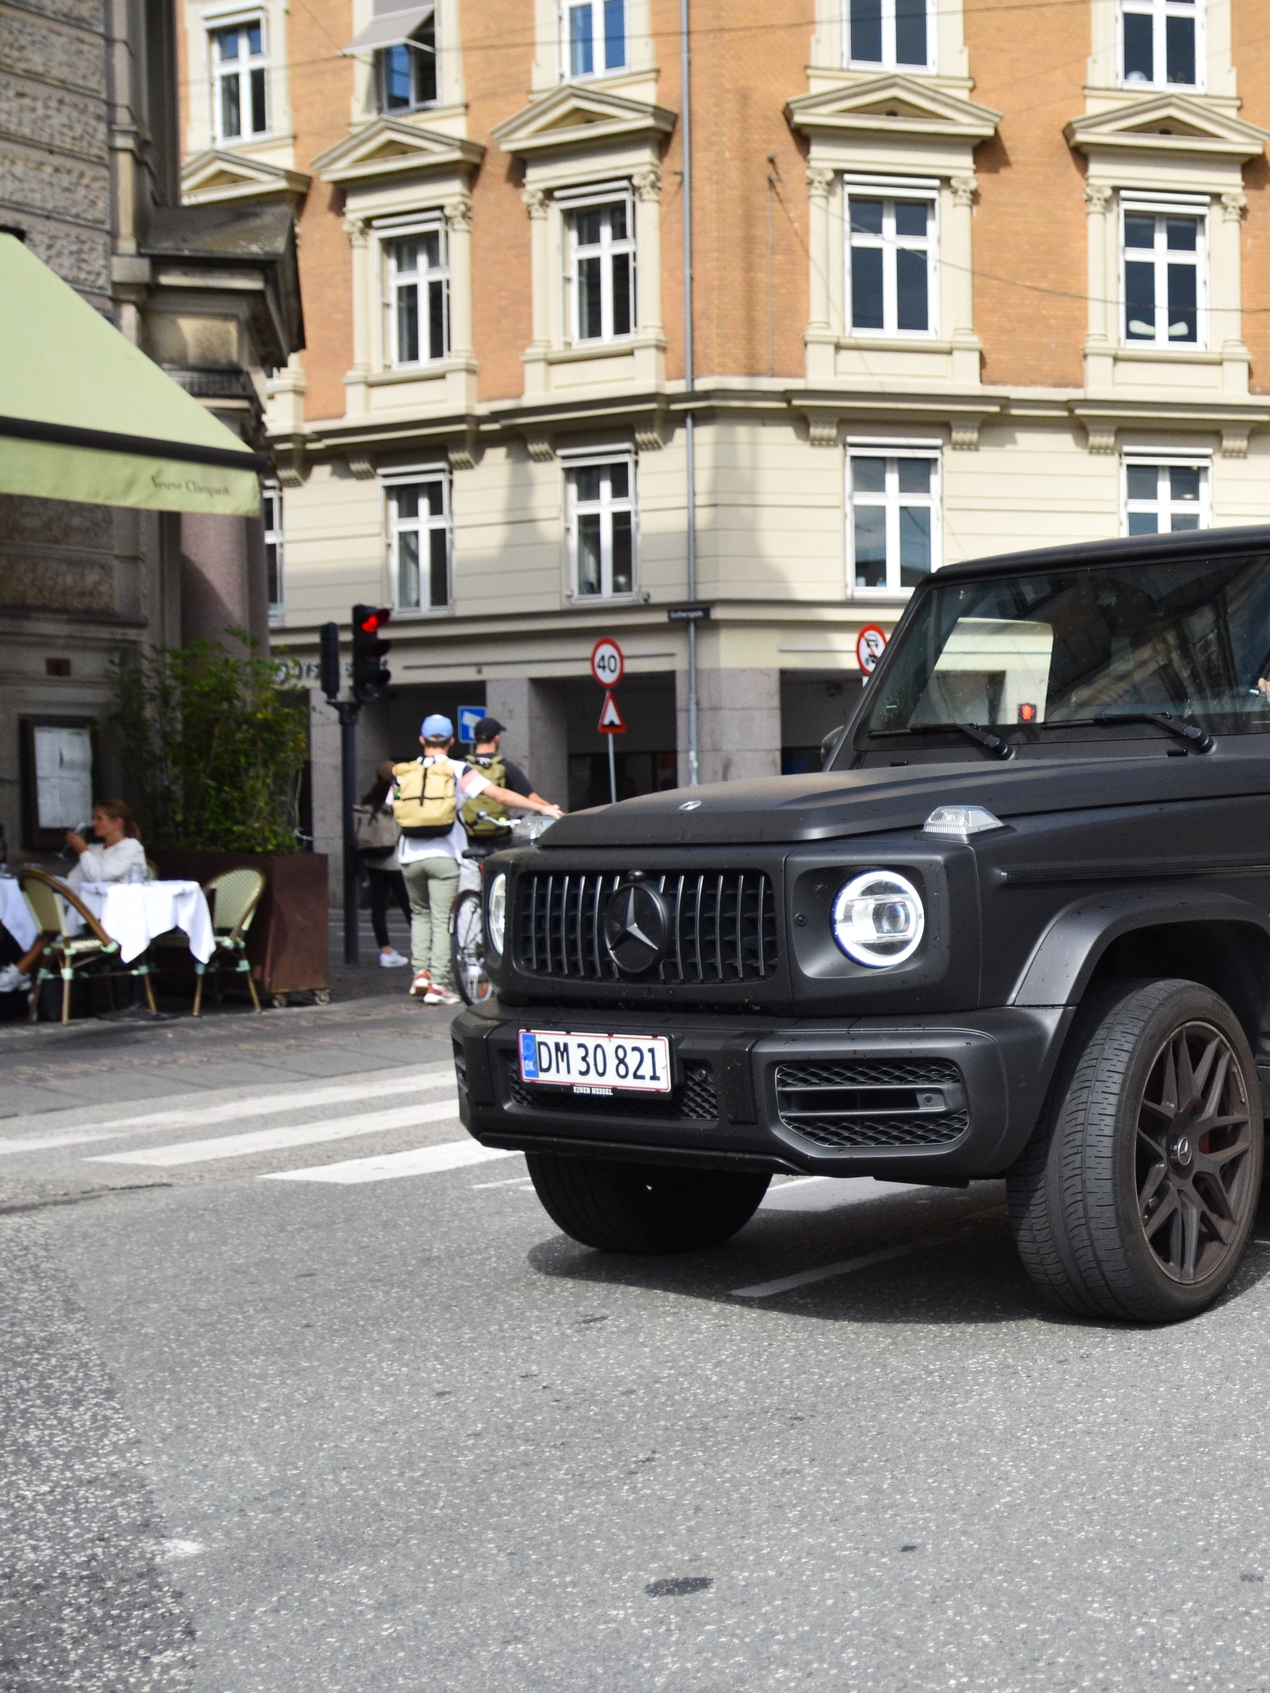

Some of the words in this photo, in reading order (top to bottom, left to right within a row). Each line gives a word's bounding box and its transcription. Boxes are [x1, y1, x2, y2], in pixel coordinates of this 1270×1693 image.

[597, 655, 617, 673] 40
[537, 1041, 571, 1075] DM
[577, 1043, 607, 1078] 30
[615, 1044, 661, 1081] 821
[573, 1086, 591, 1094] EJNER
[591, 1087, 613, 1096] HESSEL
